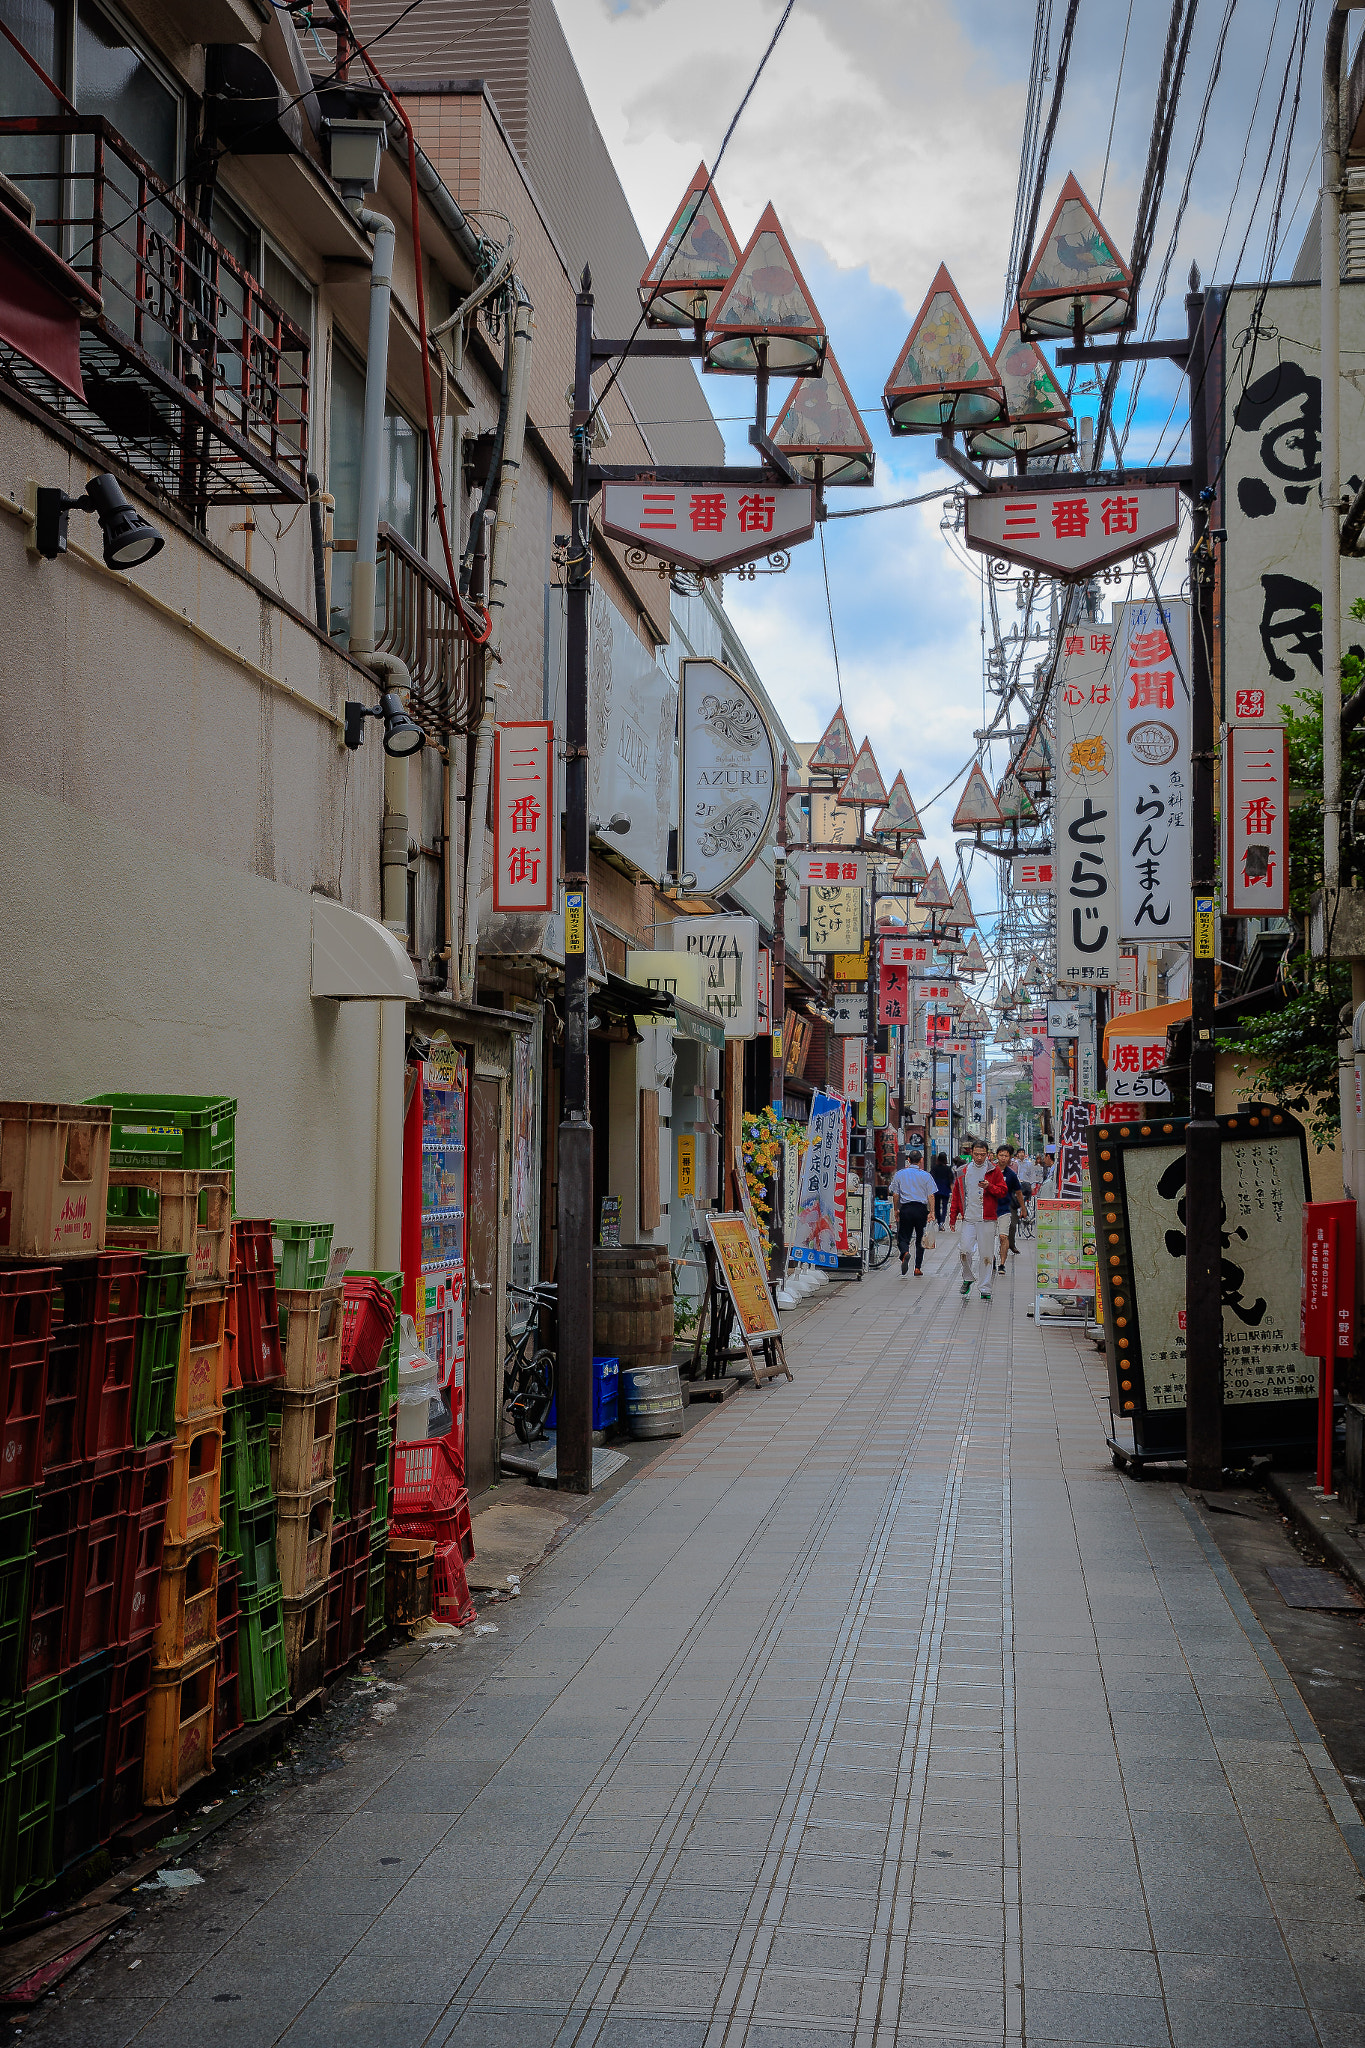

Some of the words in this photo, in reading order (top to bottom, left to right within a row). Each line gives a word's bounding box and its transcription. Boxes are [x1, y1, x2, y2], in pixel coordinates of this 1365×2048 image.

[639, 493, 777, 533] 三番街
[1002, 495, 1139, 540] 三番街
[1128, 629, 1176, 710] 多聞
[617, 719, 648, 781] AZURE
[697, 769, 769, 785] AZURE
[507, 747, 541, 884] 三番街
[695, 802, 716, 817] 2F
[1168, 771, 1185, 827] 魚料理
[808, 862, 857, 880] 三番街
[1133, 785, 1170, 927] らんまん
[1022, 865, 1054, 882] 三番
[1068, 799, 1109, 953] とらじ
[569, 908, 580, 950] 防犯カメラ作動中
[1199, 913, 1210, 955] 防犯カメラ作動中
[686, 935, 740, 959] PIZZA
[890, 947, 927, 961] 三番街
[1067, 966, 1110, 980] 中野店
[707, 994, 738, 1018] INE
[919, 986, 950, 998] 三番街
[847, 1046, 859, 1093] 三番街
[1112, 1044, 1167, 1073] 焼肉
[1113, 1078, 1168, 1098] とらじ
[822, 1111, 836, 1189] 日替わり
[682, 1152, 691, 1185] 一番搾り
[1235, 1148, 1252, 1216] おいしい地酒
[1267, 1144, 1284, 1223] おいしい料理と
[60, 1194, 88, 1221] Asahi
[53, 1224, 63, 1242] 大
[83, 1222, 92, 1240] 20
[1310, 1242, 1319, 1310] 手を触れないで下さい
[1321, 1242, 1329, 1297] 非常の場合以外は
[1224, 1329, 1285, 1342] 北口駅前店
[1338, 1308, 1350, 1346] 中野区
[1152, 1384, 1188, 1395] 営業時
[1266, 1375, 1315, 1386] AM5:00
[1224, 1363, 1296, 1377] ス付き個室完備
[1272, 1384, 1316, 1396] 年中無休
